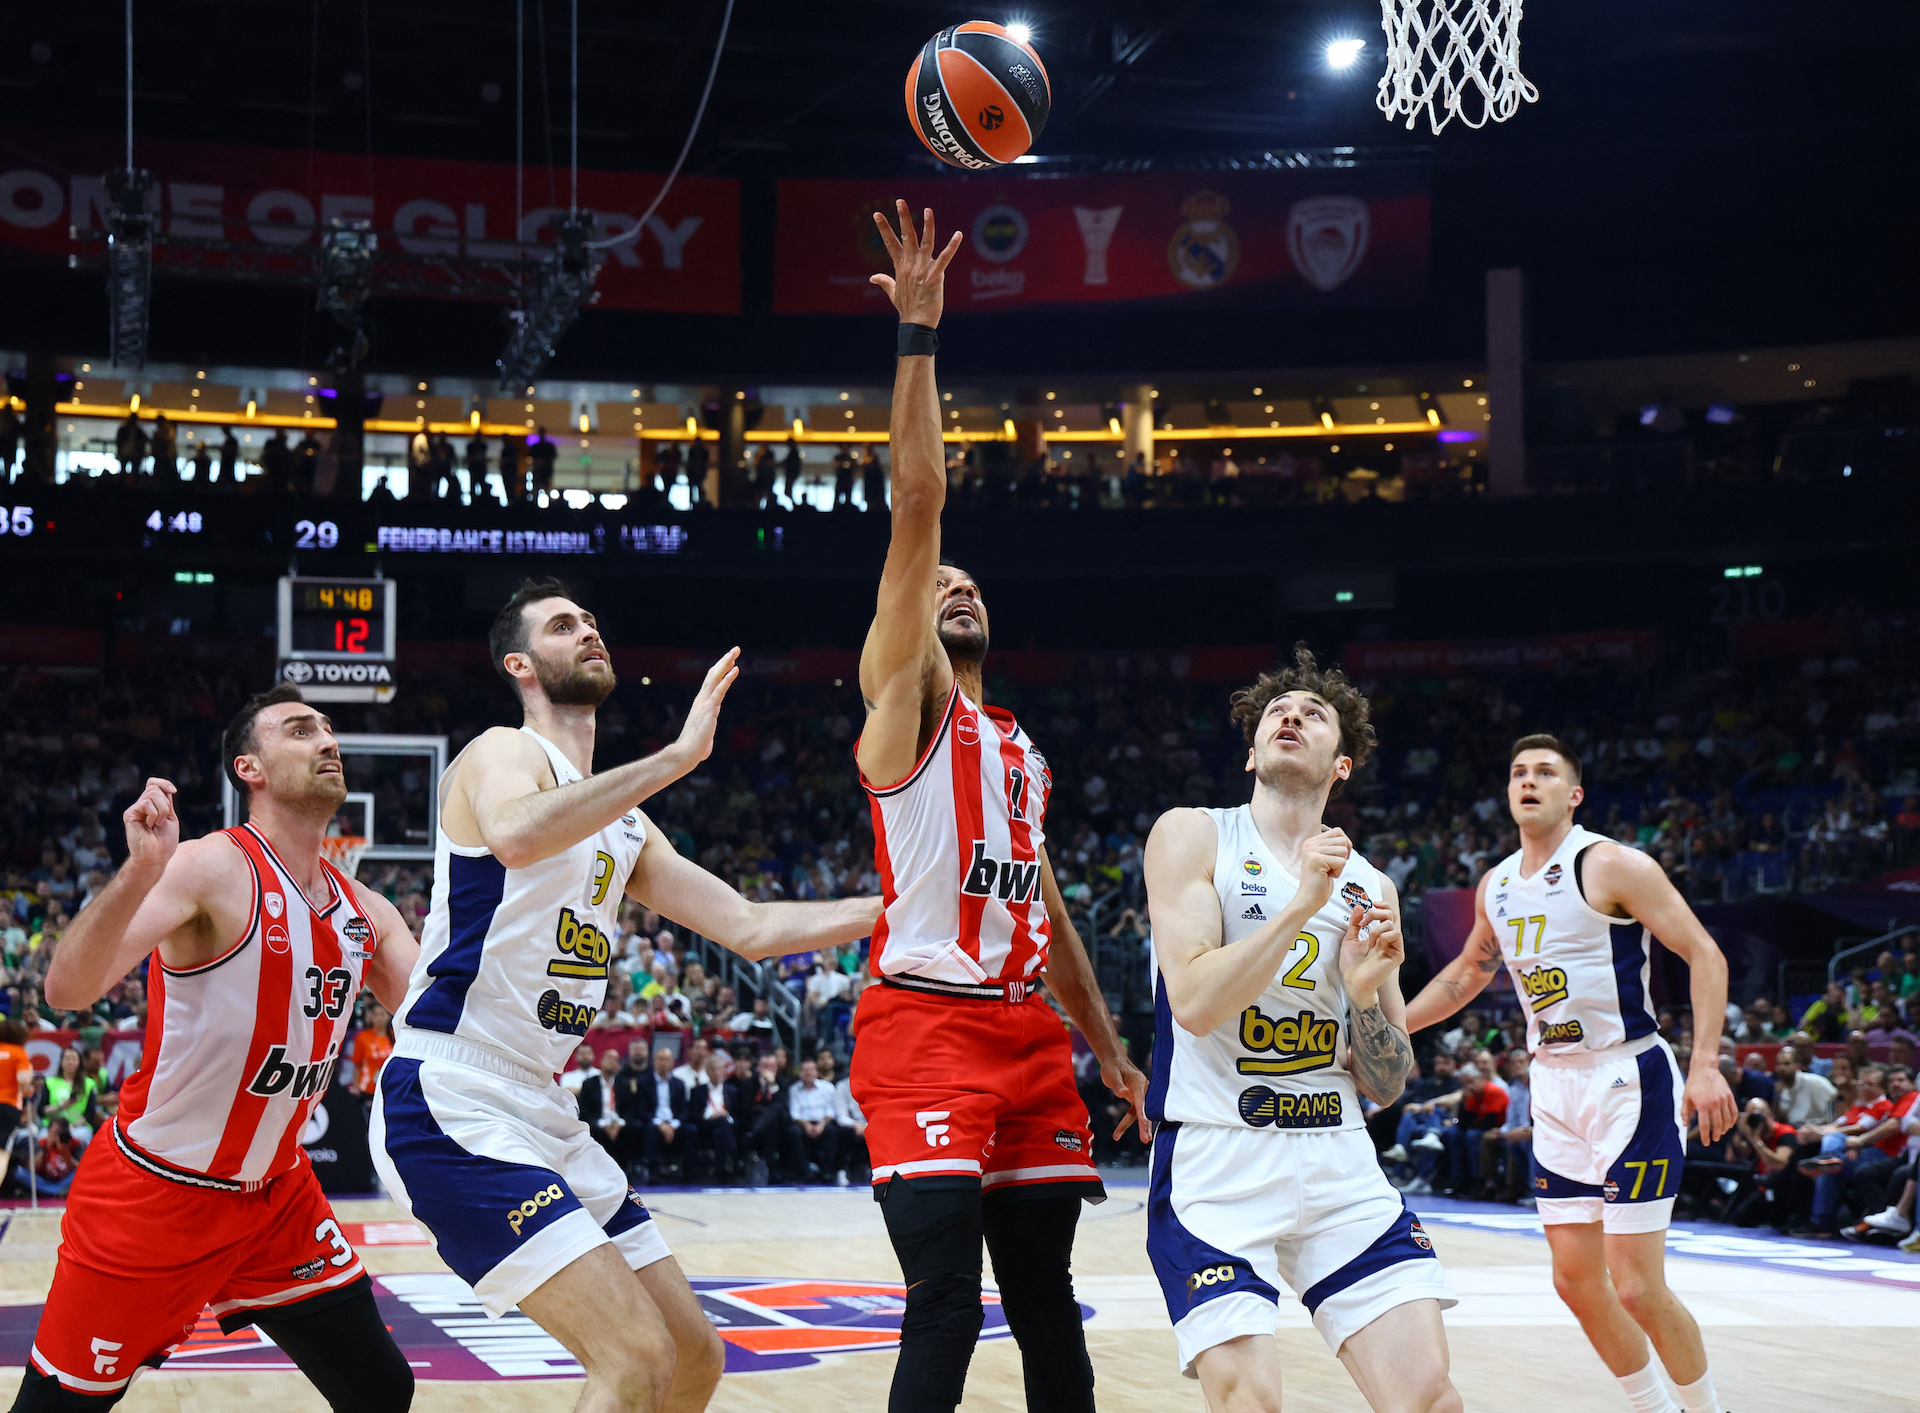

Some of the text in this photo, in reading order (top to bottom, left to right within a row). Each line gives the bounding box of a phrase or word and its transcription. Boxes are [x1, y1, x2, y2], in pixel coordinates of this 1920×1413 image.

[922, 87, 992, 170] SPALDING
[247, 188, 374, 250] OF
[393, 198, 704, 270] GLORY
[146, 509, 203, 534] 4:48
[294, 519, 339, 549] 29
[334, 617, 369, 653] 12
[314, 664, 392, 682] TOYOTA
[957, 724, 979, 734] GSA
[1009, 766, 1026, 821] 1
[591, 850, 615, 906] 9
[1241, 881, 1267, 893] beko
[1241, 912, 1267, 921] adidas
[1507, 914, 1547, 957] 77
[558, 910, 610, 964] beo
[1282, 931, 1320, 991] 2
[302, 964, 352, 1020] 33
[1518, 965, 1568, 999] beko
[1240, 1006, 1339, 1054] beko
[1278, 1094, 1341, 1117] RAMS
[1278, 1116, 1341, 1126] GLOBAL
[1623, 1158, 1670, 1200] 77
[506, 1183, 565, 1237] poca
[292, 1259, 326, 1277] FINAL FOUR
